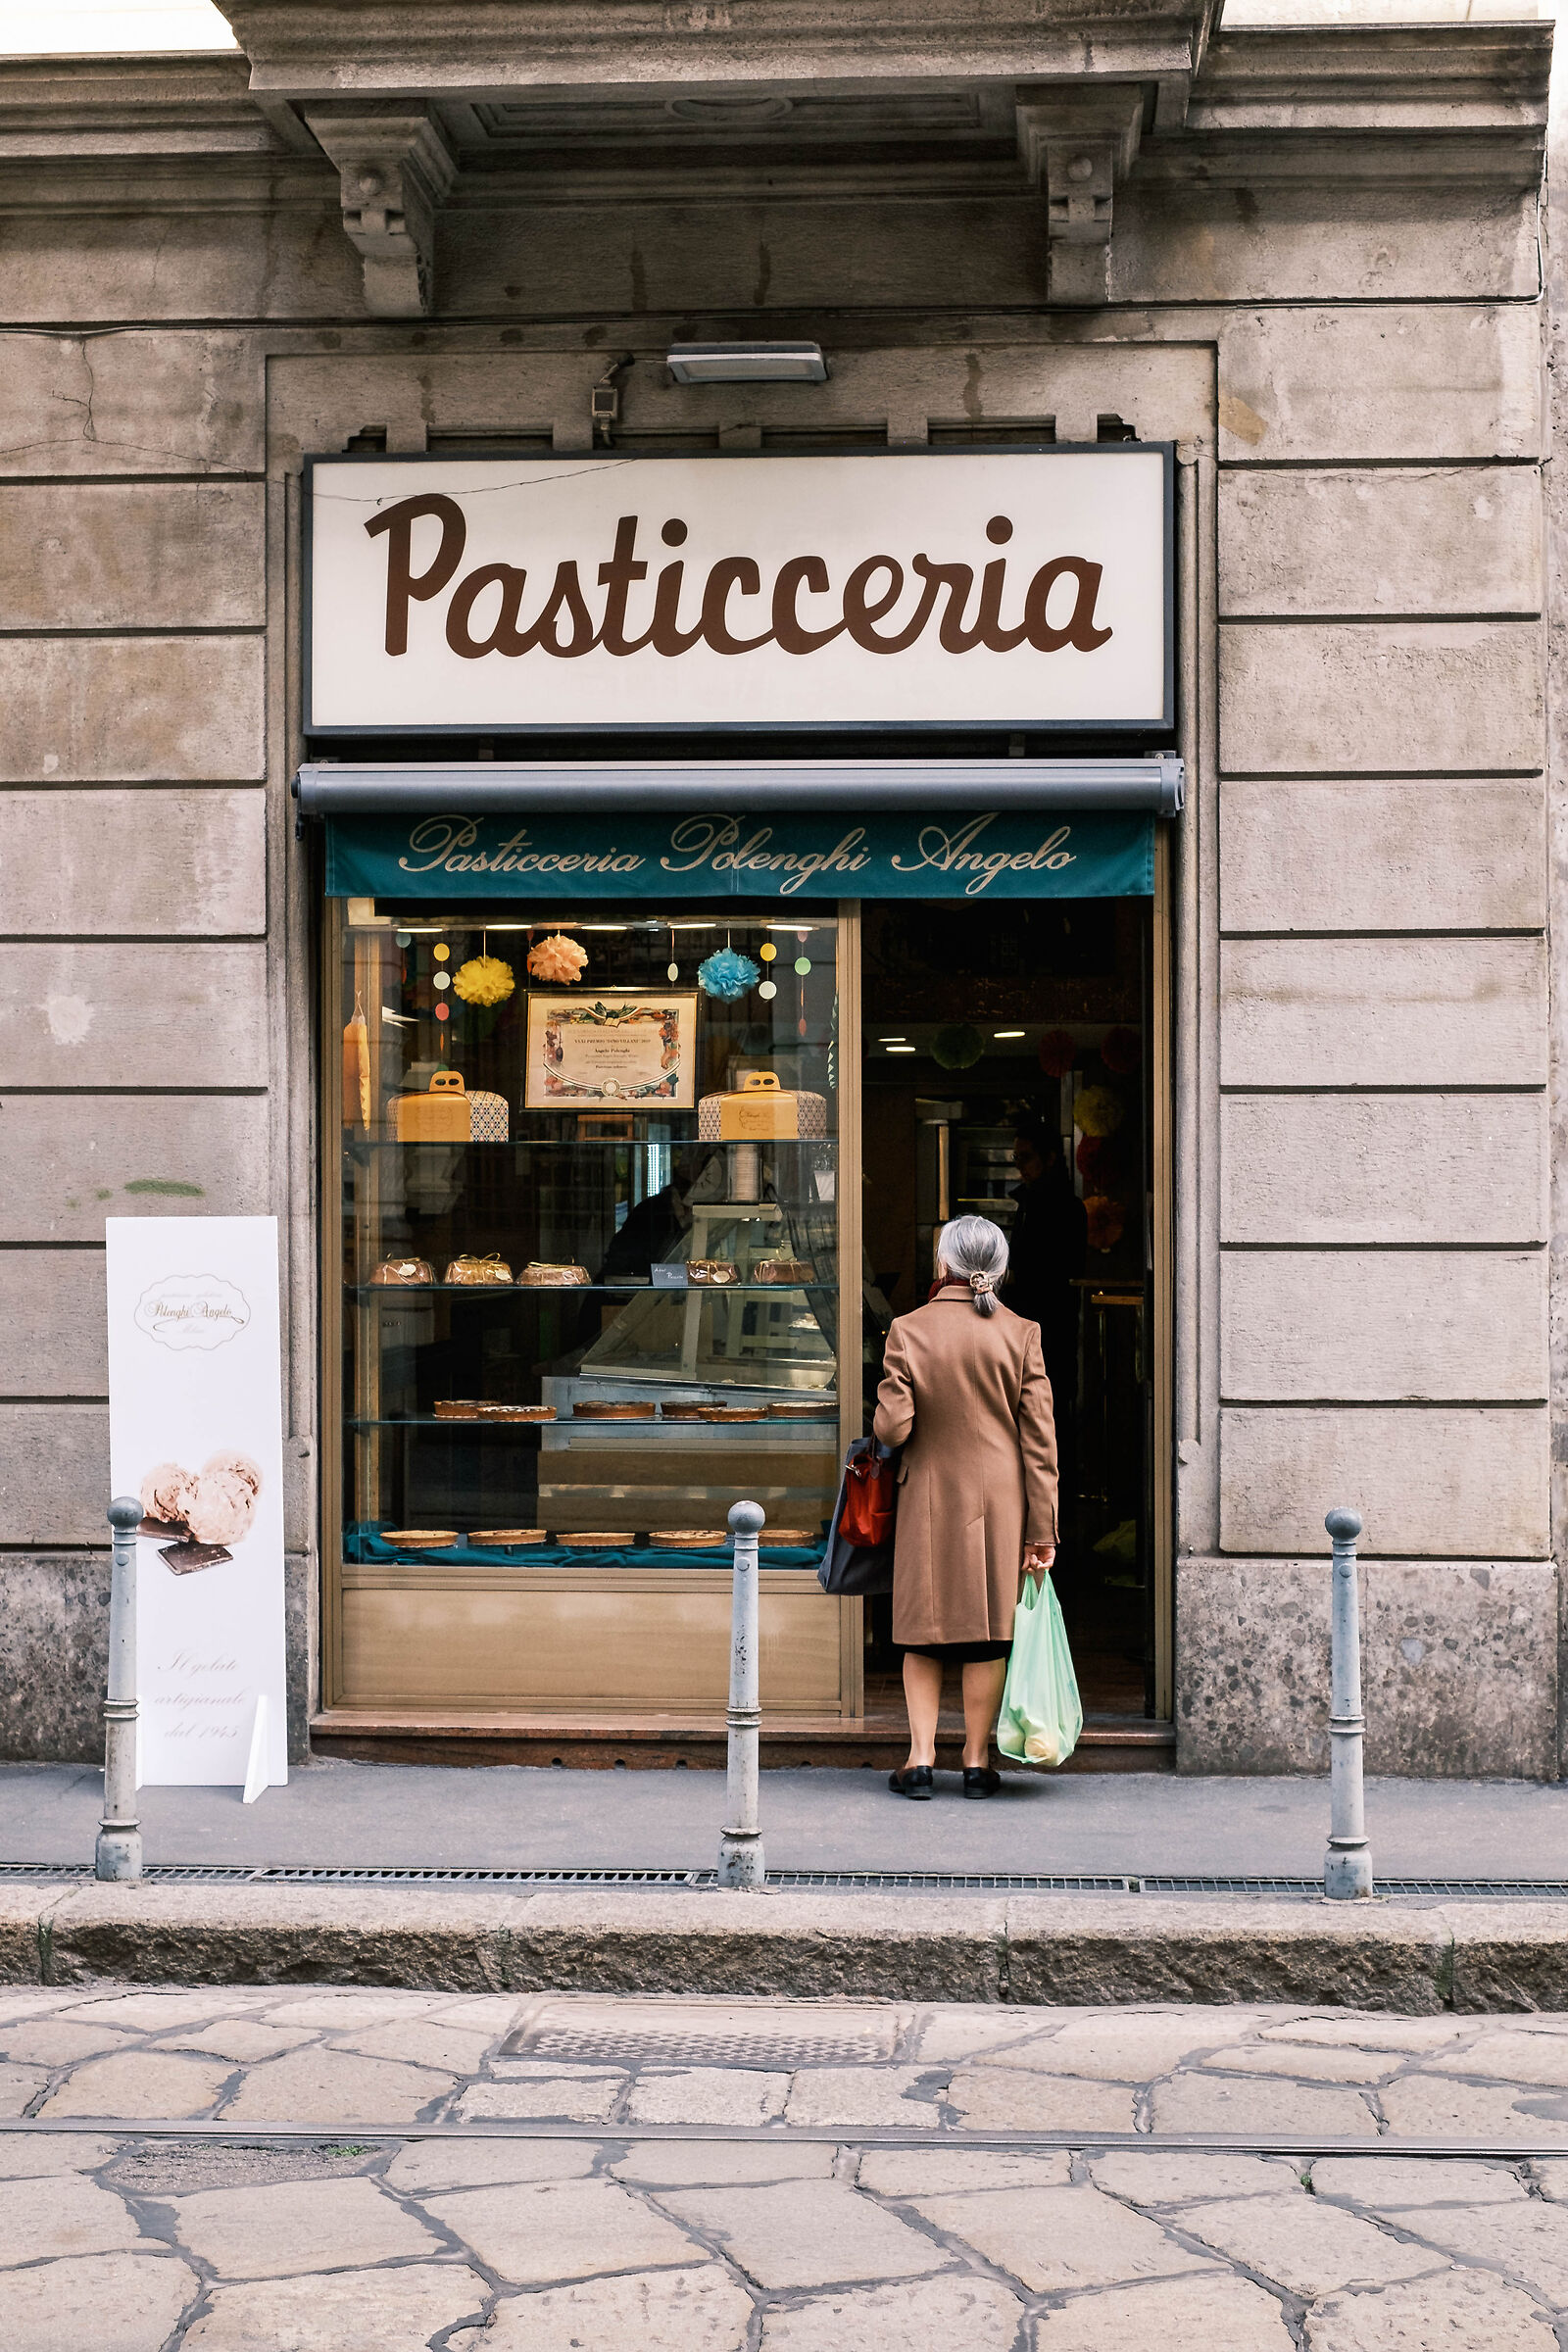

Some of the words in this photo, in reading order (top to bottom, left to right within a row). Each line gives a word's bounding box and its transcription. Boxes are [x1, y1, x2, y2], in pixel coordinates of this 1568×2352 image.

[364, 493, 1113, 660] Pasticceria
[398, 814, 646, 872] Pasticceria
[660, 814, 871, 896] Polenghi
[891, 811, 1077, 896] Angelo
